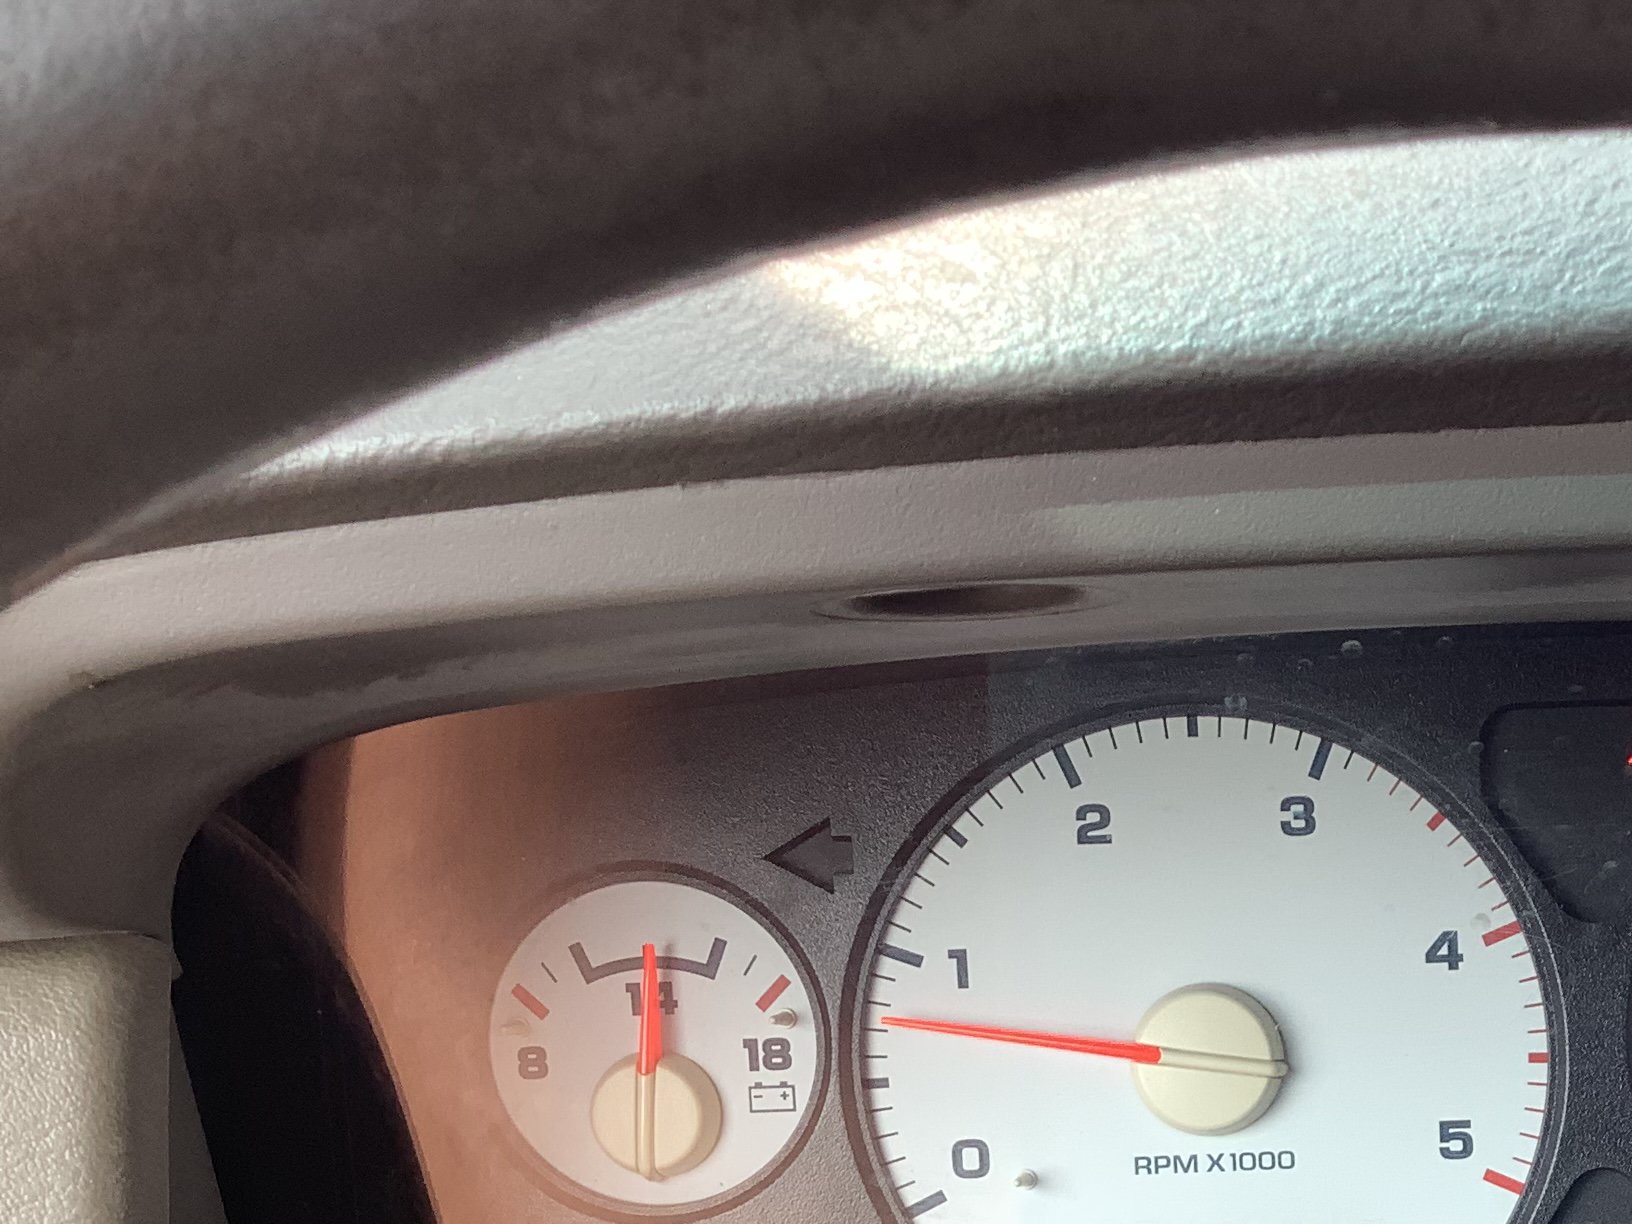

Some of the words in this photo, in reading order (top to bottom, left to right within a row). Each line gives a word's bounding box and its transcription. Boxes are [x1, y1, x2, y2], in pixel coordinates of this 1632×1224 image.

[1075, 803, 1113, 845] 2
[1279, 795, 1317, 837] 3
[947, 948, 970, 990] 1
[1424, 930, 1464, 971] 4
[624, 982, 679, 1017] 14
[517, 1045, 549, 1080] 8
[742, 1037, 793, 1072] 18
[951, 1138, 991, 1179] 0
[1438, 1119, 1474, 1160] 5
[1134, 1154, 1199, 1176] RPM
[1206, 1150, 1296, 1173] X1000
